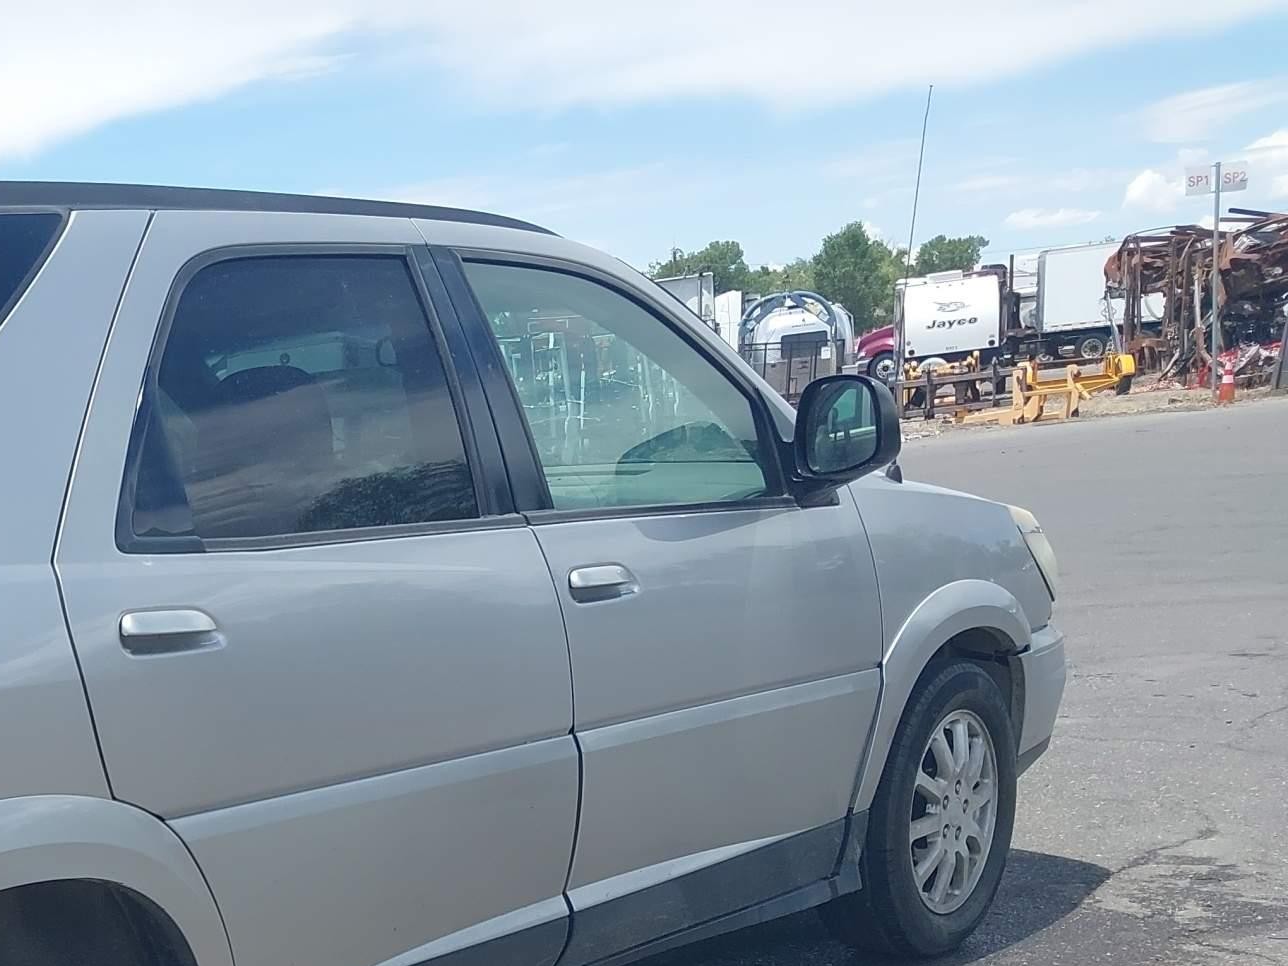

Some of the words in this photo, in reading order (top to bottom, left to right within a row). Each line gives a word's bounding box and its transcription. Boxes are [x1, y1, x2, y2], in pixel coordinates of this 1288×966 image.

[1187, 175, 1209, 188] SP1
[1223, 170, 1248, 185] SP2
[925, 316, 979, 330] Jayco
